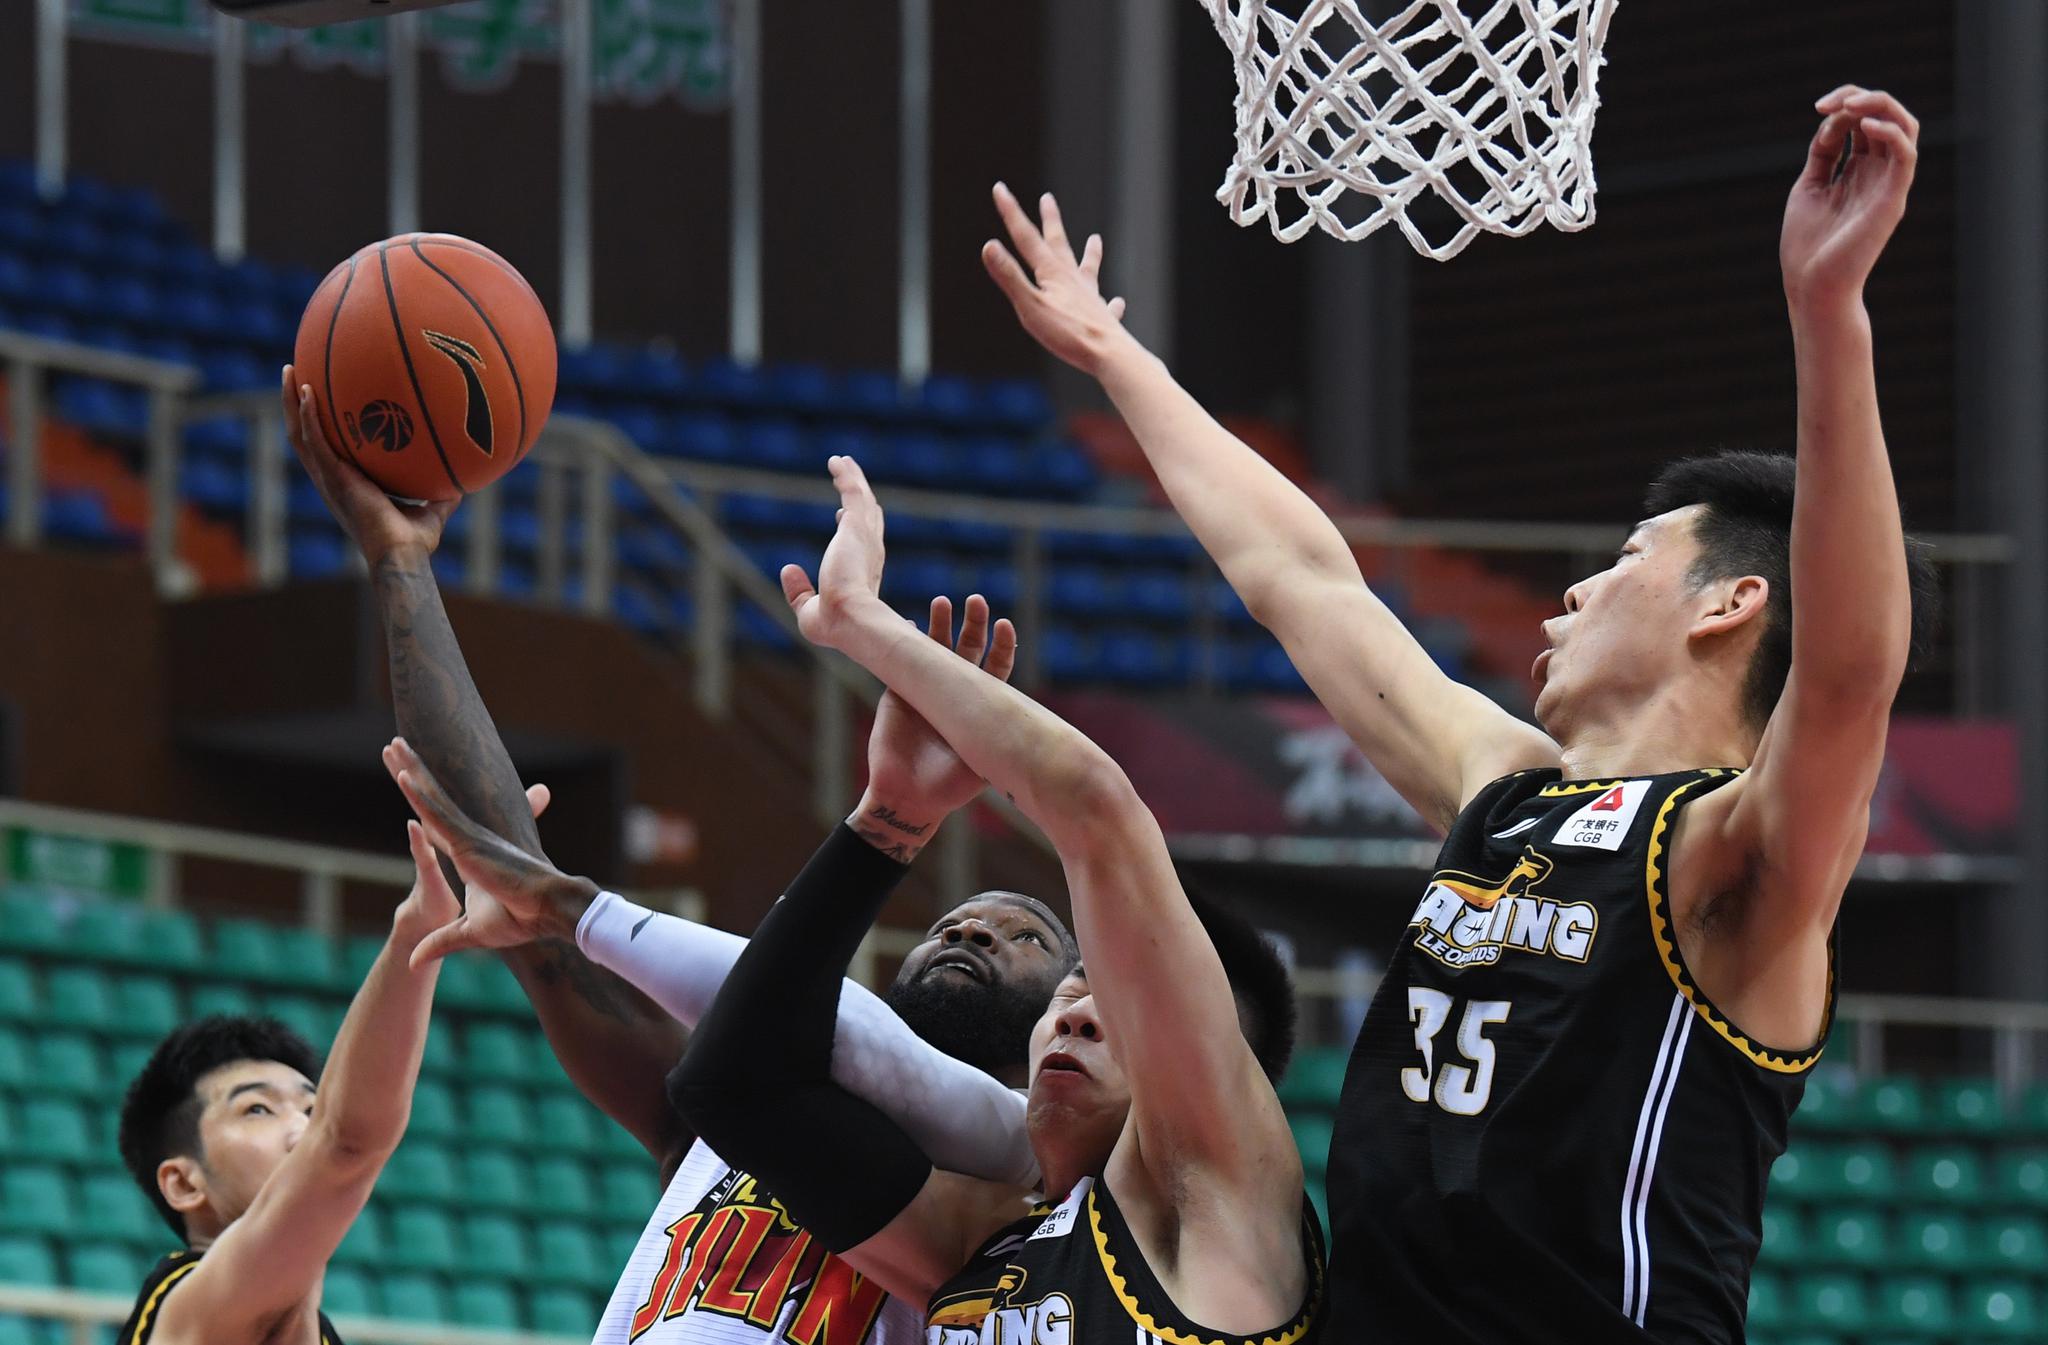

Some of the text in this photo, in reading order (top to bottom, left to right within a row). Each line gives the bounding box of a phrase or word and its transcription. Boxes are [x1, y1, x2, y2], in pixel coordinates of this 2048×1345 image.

[1571, 818, 1620, 832] 广发银行
[1573, 831, 1603, 844] CGB
[1400, 986, 1514, 1117] 35
[629, 1205, 887, 1345] JILIN
